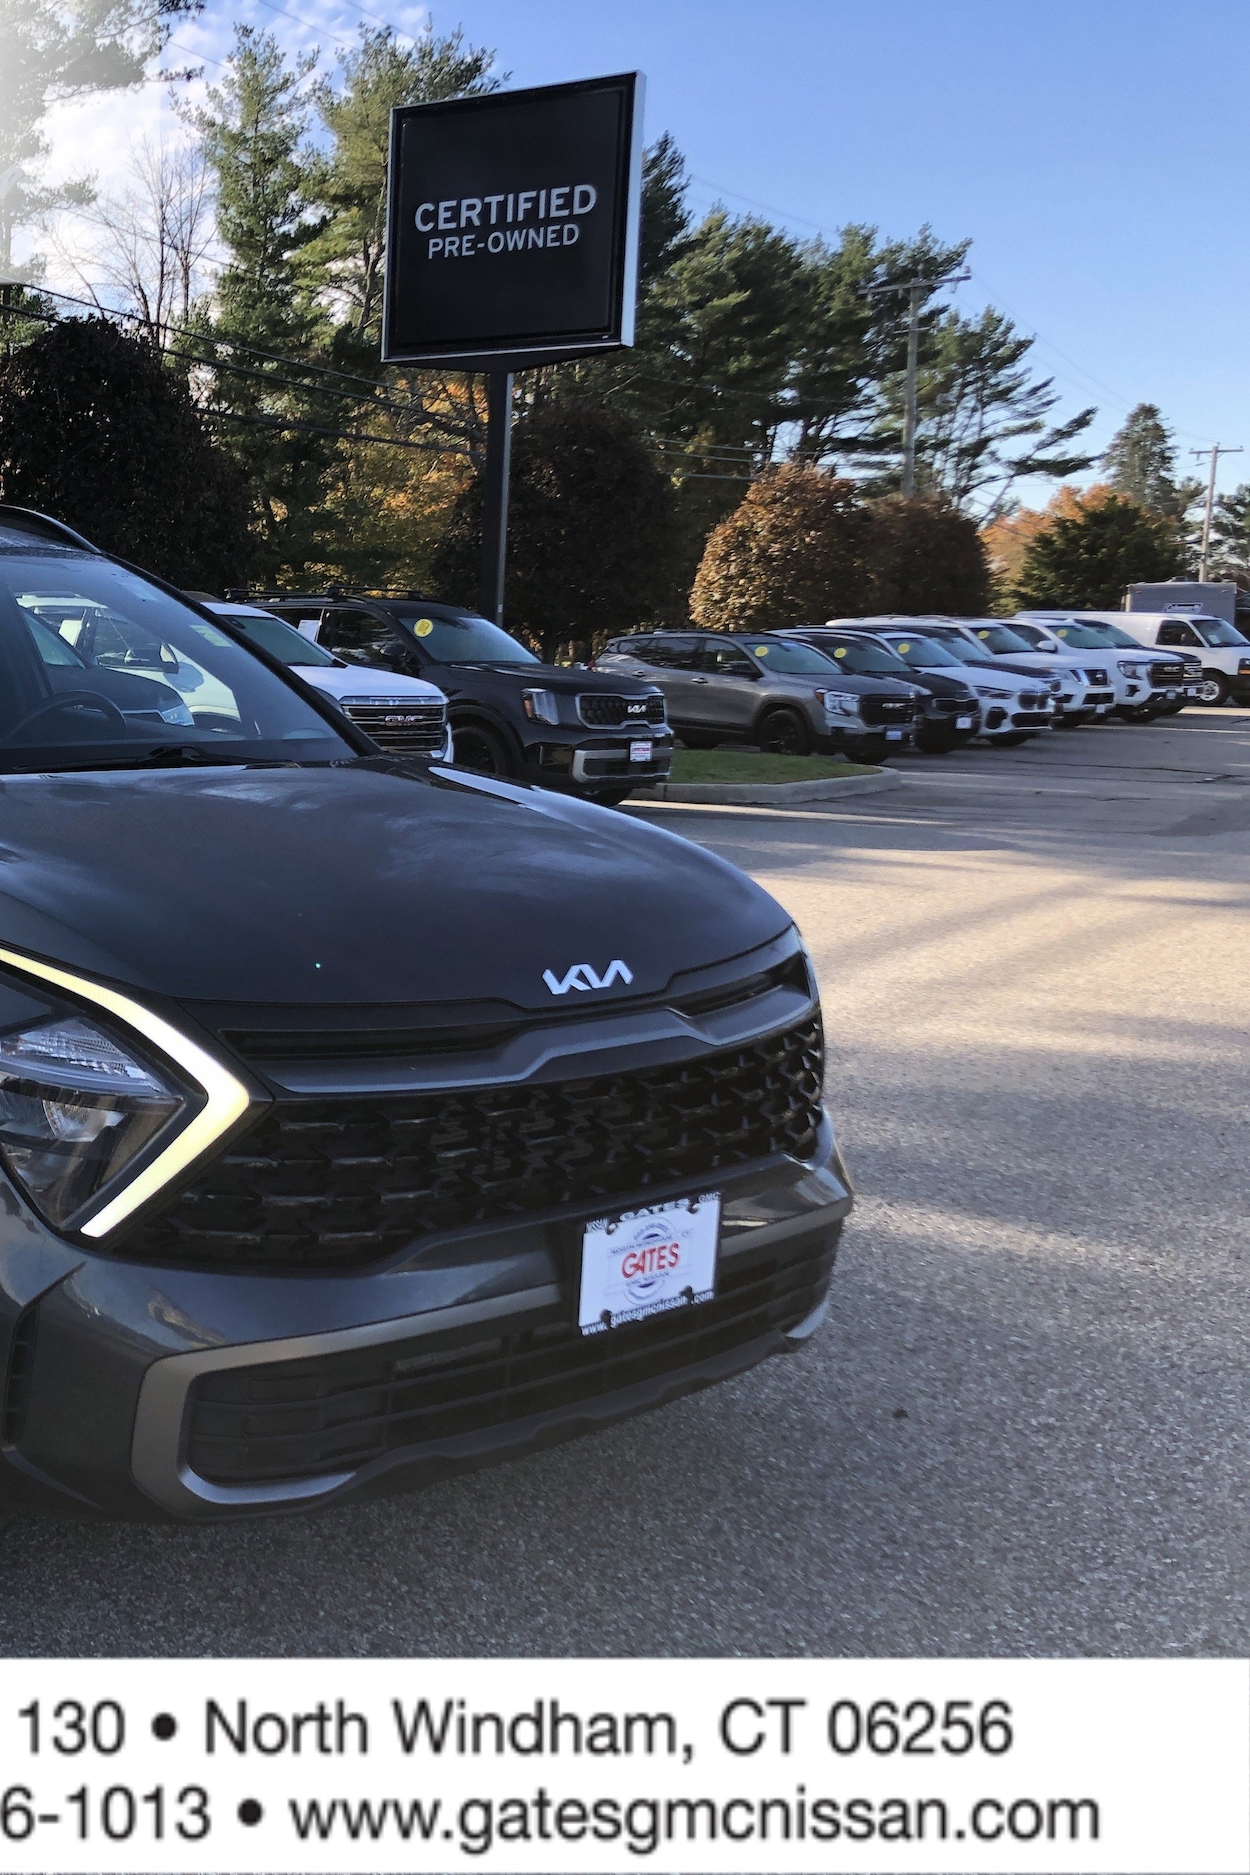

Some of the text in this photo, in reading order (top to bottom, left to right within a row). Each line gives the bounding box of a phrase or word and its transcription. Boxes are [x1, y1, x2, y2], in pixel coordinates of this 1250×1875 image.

[414, 184, 598, 232] CERTIFIED
[428, 223, 580, 260] PRE-OWNED
[541, 959, 633, 996] KIA
[621, 1242, 680, 1279] GATES
